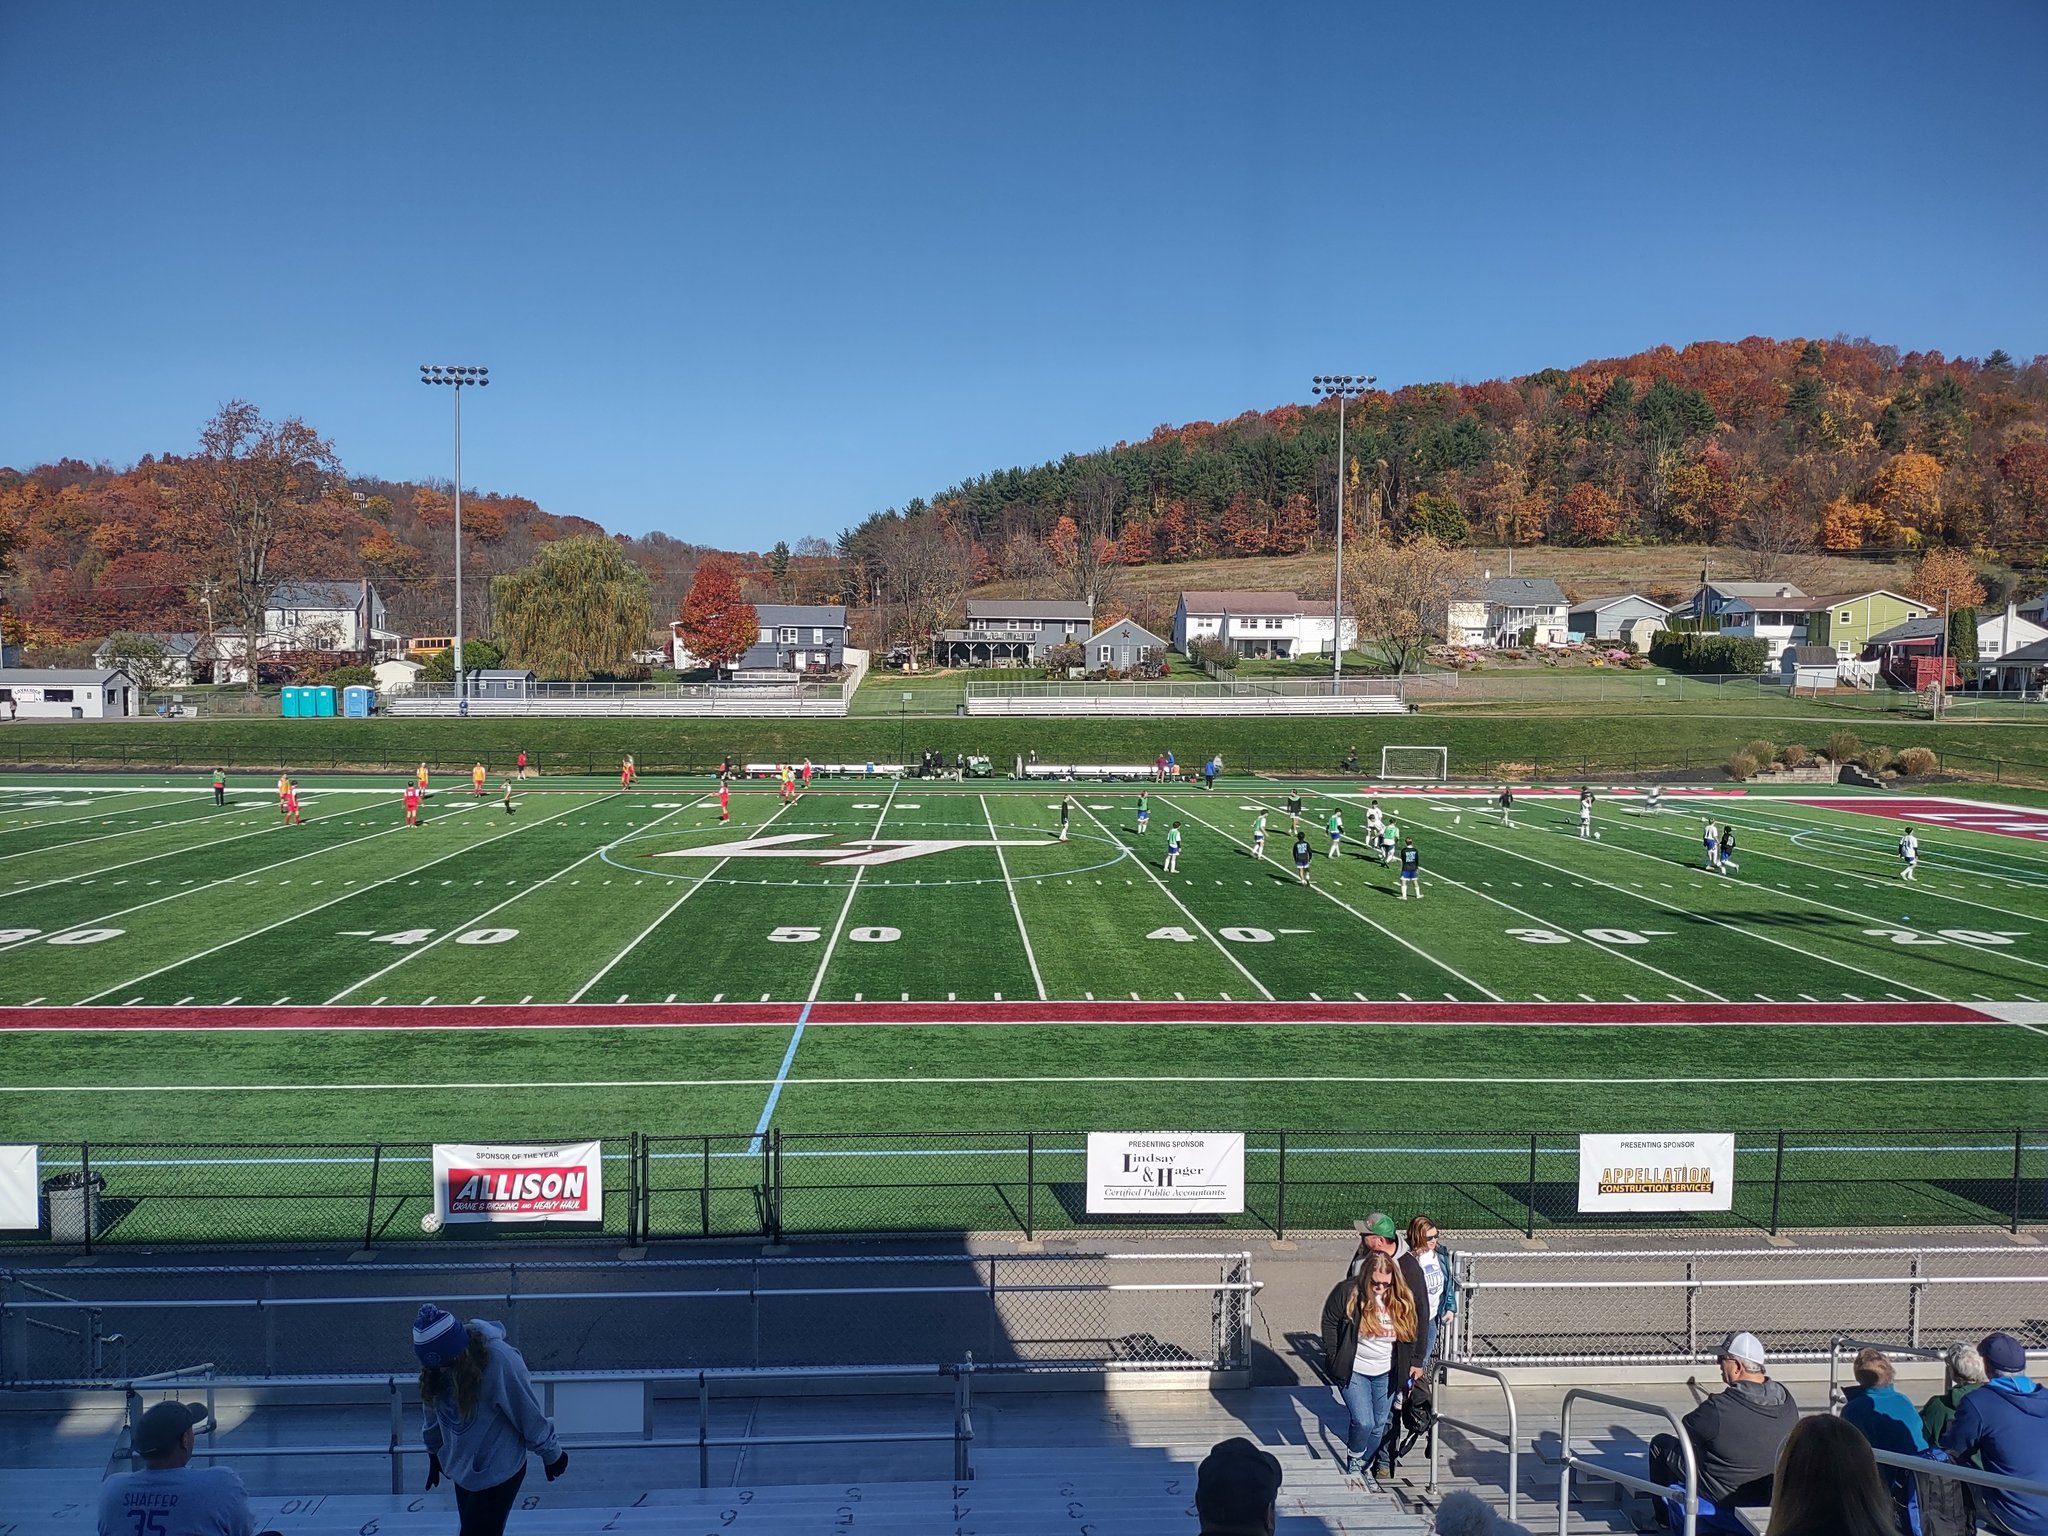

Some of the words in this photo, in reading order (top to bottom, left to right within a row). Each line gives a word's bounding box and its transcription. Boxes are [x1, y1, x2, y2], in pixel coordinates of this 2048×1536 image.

[1620, 1141, 1662, 1149] PRESENTING
[1663, 1141, 1695, 1149] SPONSOR
[476, 1152, 510, 1160] SPONSOR
[1122, 1153, 1177, 1173] Lindsay
[1142, 1166, 1154, 1182] &
[1156, 1167, 1204, 1187] Hager
[1601, 1166, 1711, 1184] APPELLATION
[455, 1172, 585, 1201] ALLISON
[1104, 1188, 1141, 1198] Certified
[1143, 1188, 1170, 1197] Public
[1172, 1188, 1225, 1197] Accountants
[1600, 1184, 1669, 1193] CONSTRUCTION
[1670, 1183, 1712, 1192] SERVICES
[452, 1201, 477, 1211] CRANE
[486, 1201, 518, 1211] RIGGING
[533, 1201, 559, 1210] HEAVY
[559, 1200, 580, 1209] HAUL
[123, 1494, 179, 1508] SHAFFER
[126, 1508, 170, 1536] 35
